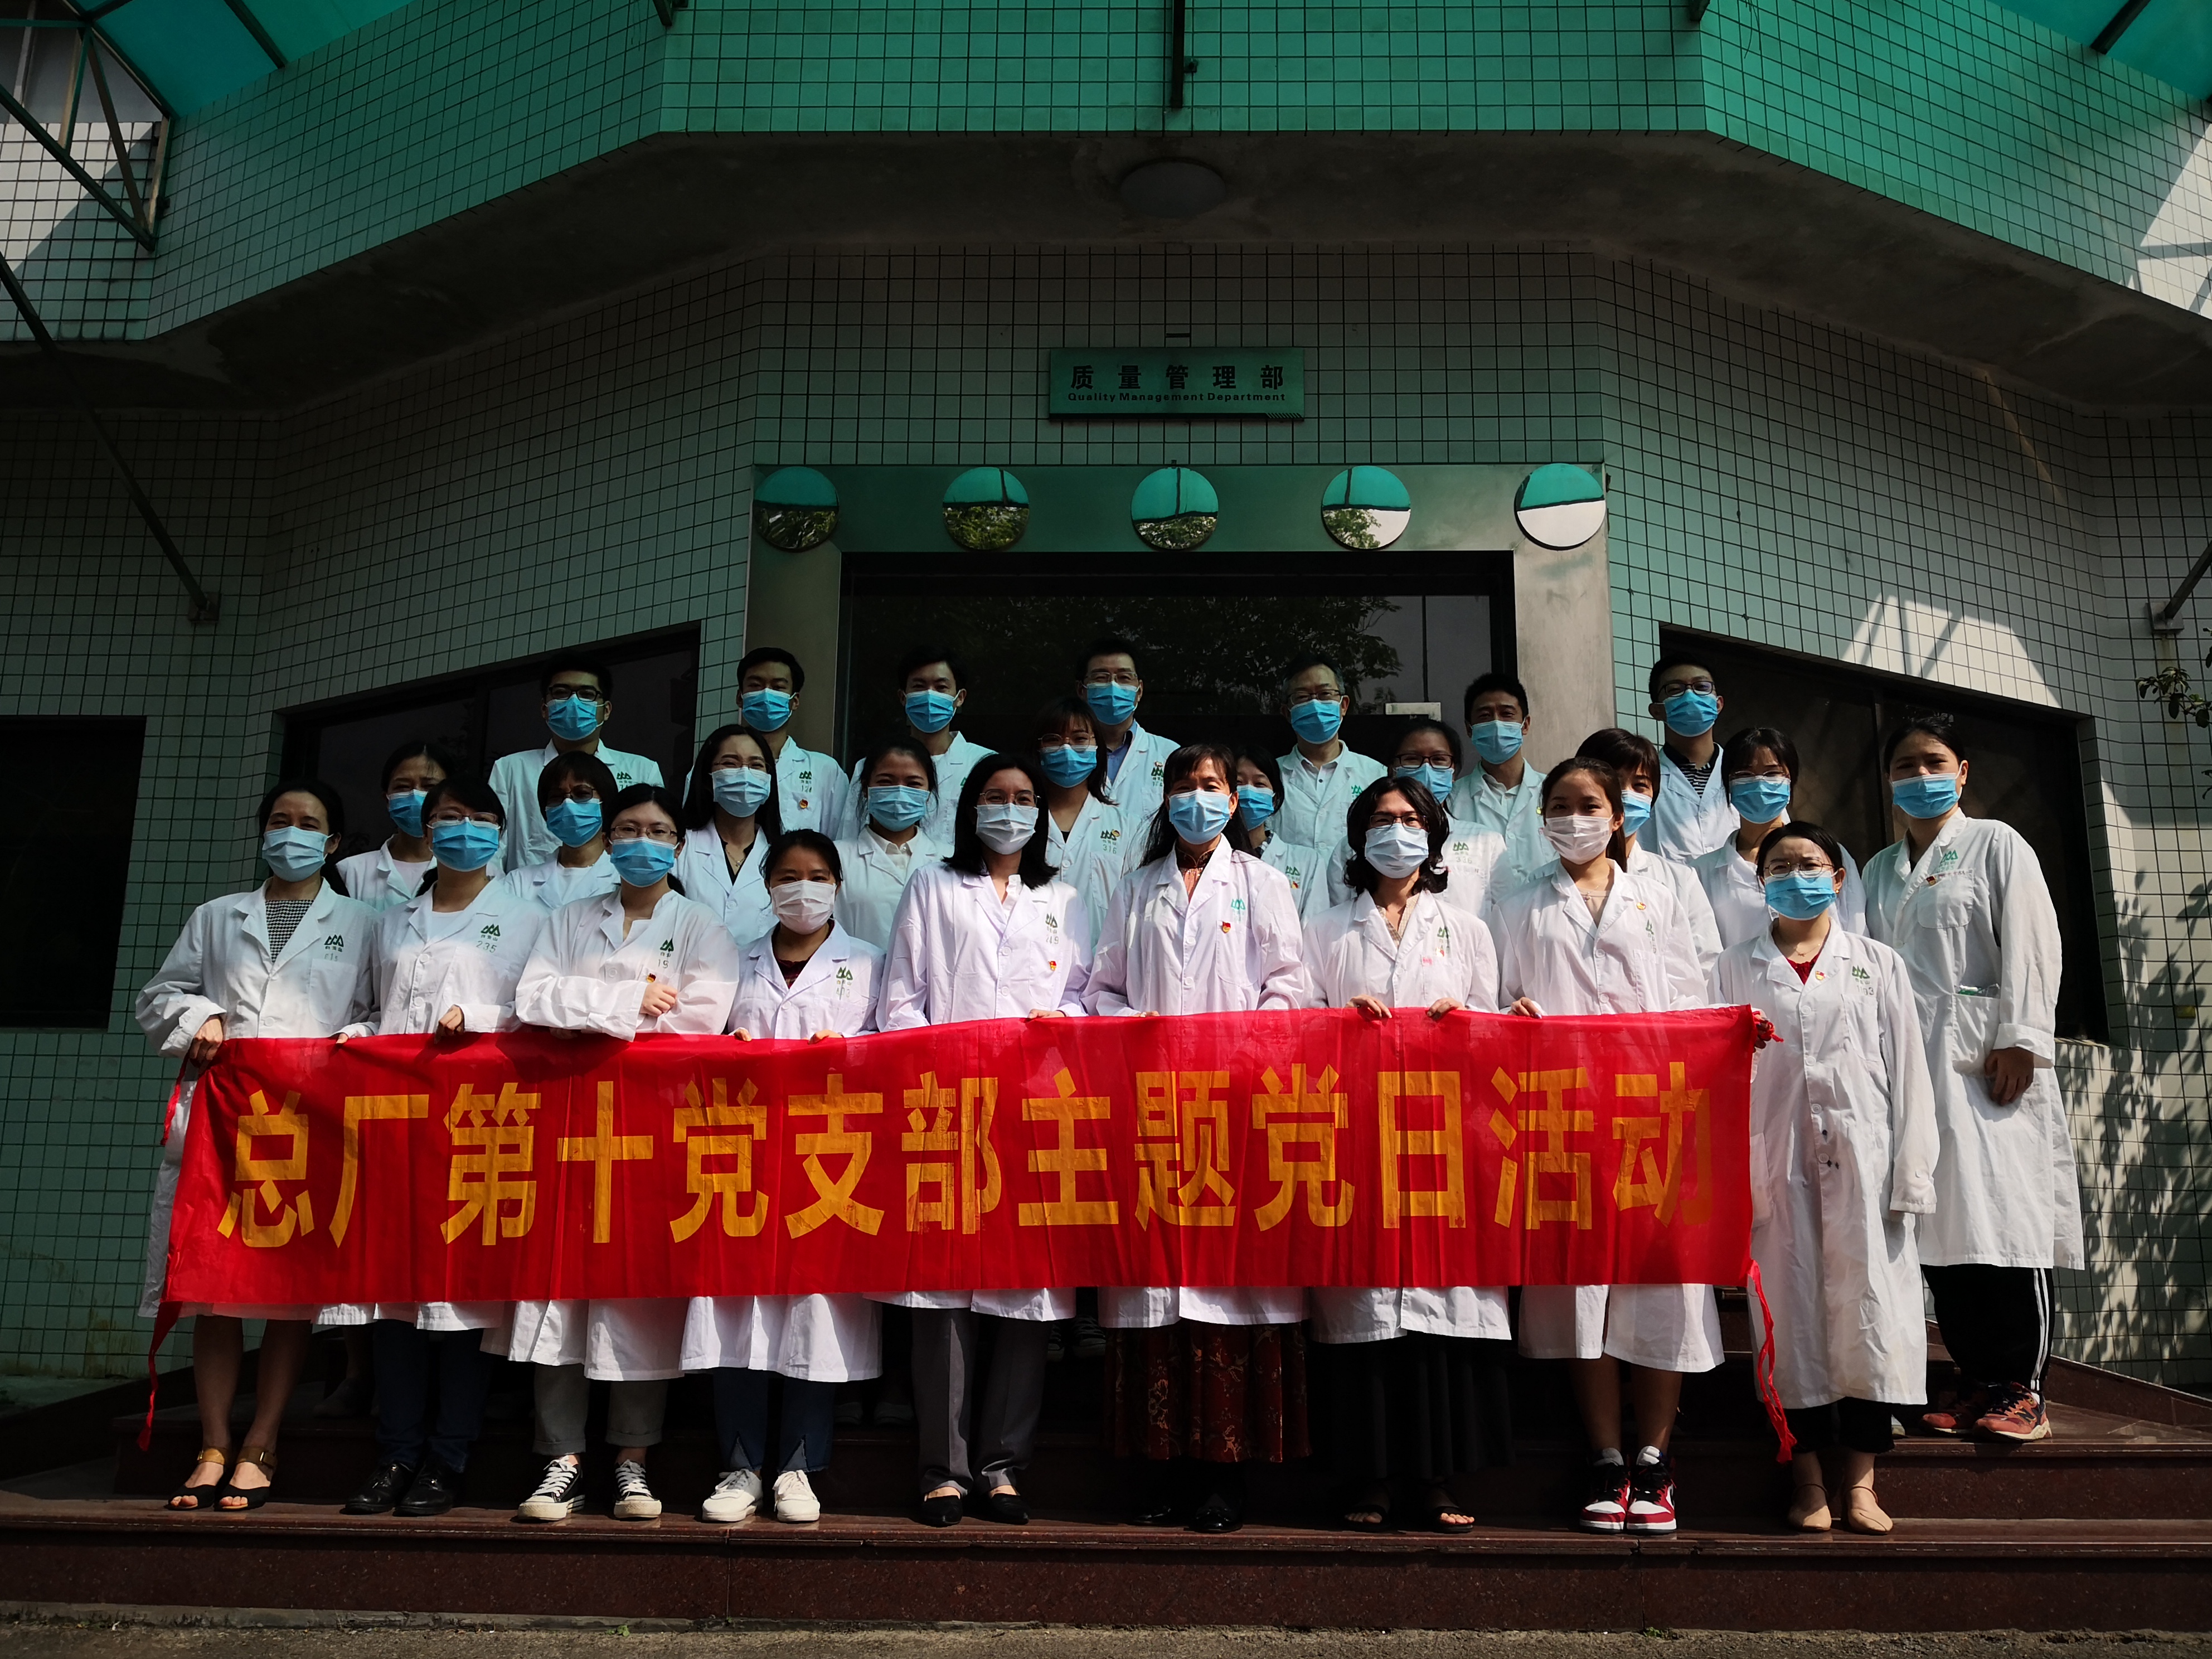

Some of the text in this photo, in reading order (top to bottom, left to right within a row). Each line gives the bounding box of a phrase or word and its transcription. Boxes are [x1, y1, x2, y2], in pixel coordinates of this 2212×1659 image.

[1070, 365, 1283, 390] 质量管理部
[1068, 392, 1285, 402] Quality Management Department
[476, 940, 497, 953] 235
[217, 1061, 1714, 1249] 总厂第十党支部主题党日活动
